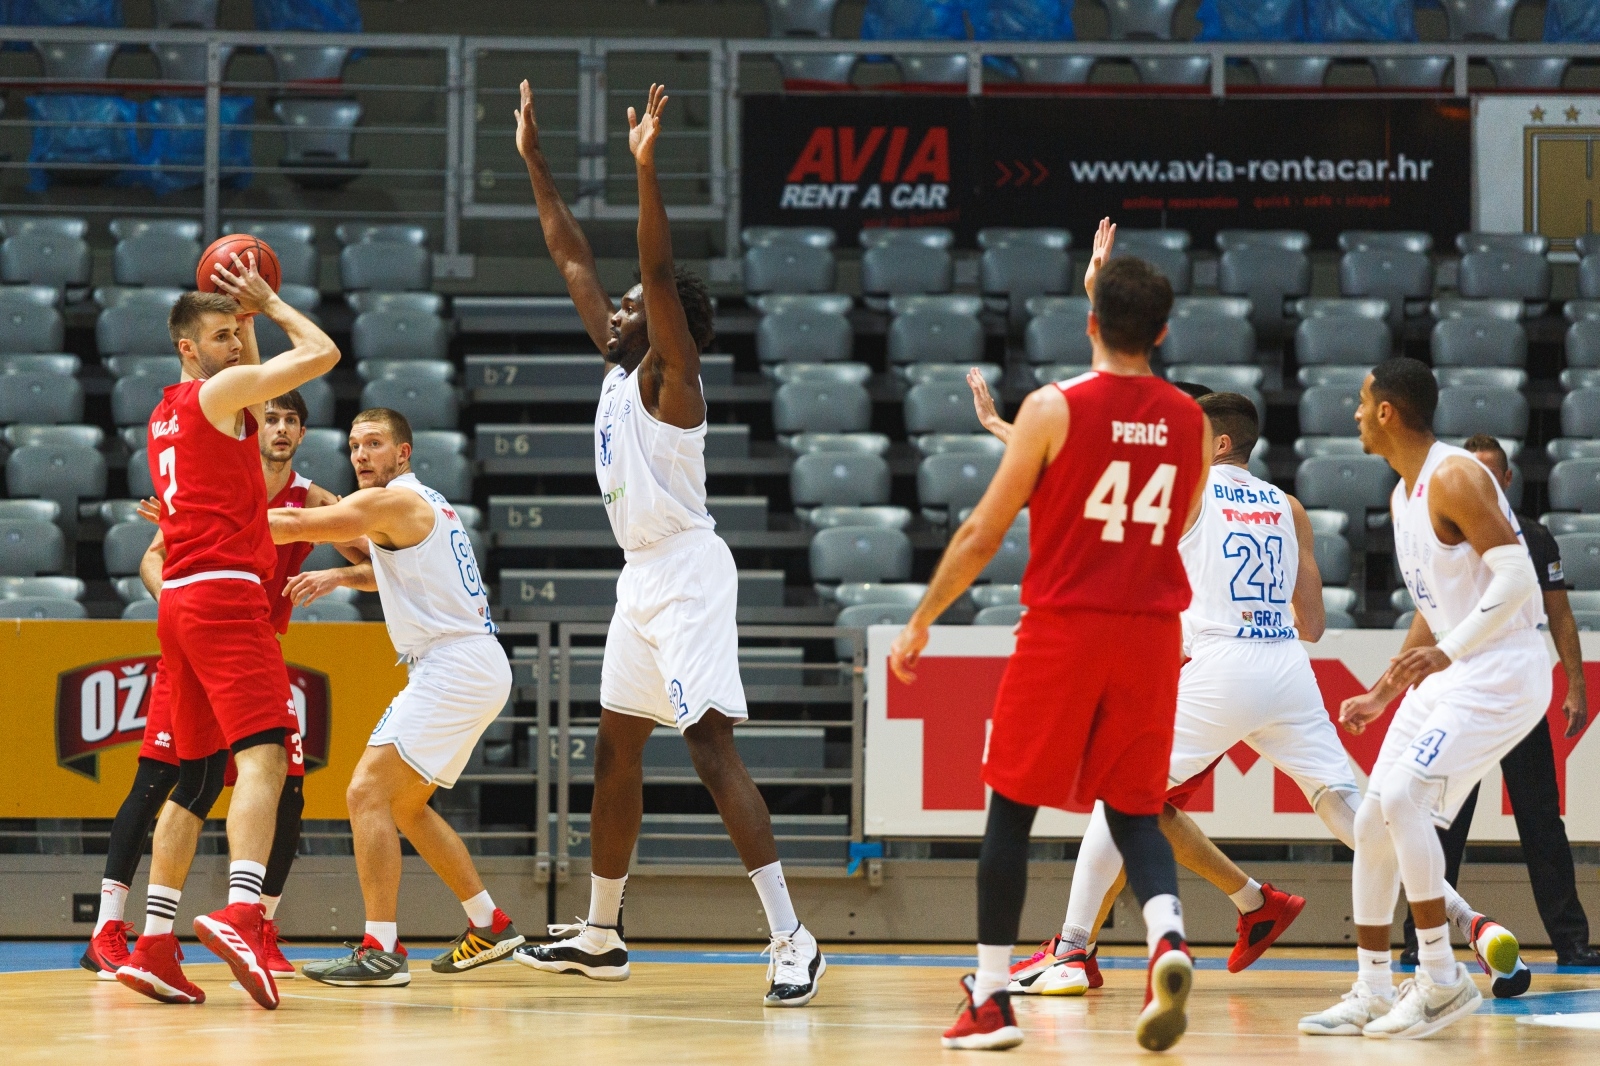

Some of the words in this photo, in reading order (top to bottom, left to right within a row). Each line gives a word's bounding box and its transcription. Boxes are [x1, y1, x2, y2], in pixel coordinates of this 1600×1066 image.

[786, 127, 950, 183] AVIA
[1070, 153, 1434, 183] www.avia-rentacar.hr
[780, 184, 858, 209] RENT
[861, 184, 882, 209] A
[891, 184, 949, 209] CAR
[1111, 418, 1168, 446] PERIĆ
[159, 446, 178, 516] 7
[1084, 460, 1178, 546] 44
[1222, 509, 1282, 525] TOMMY
[1222, 532, 1286, 603] 21
